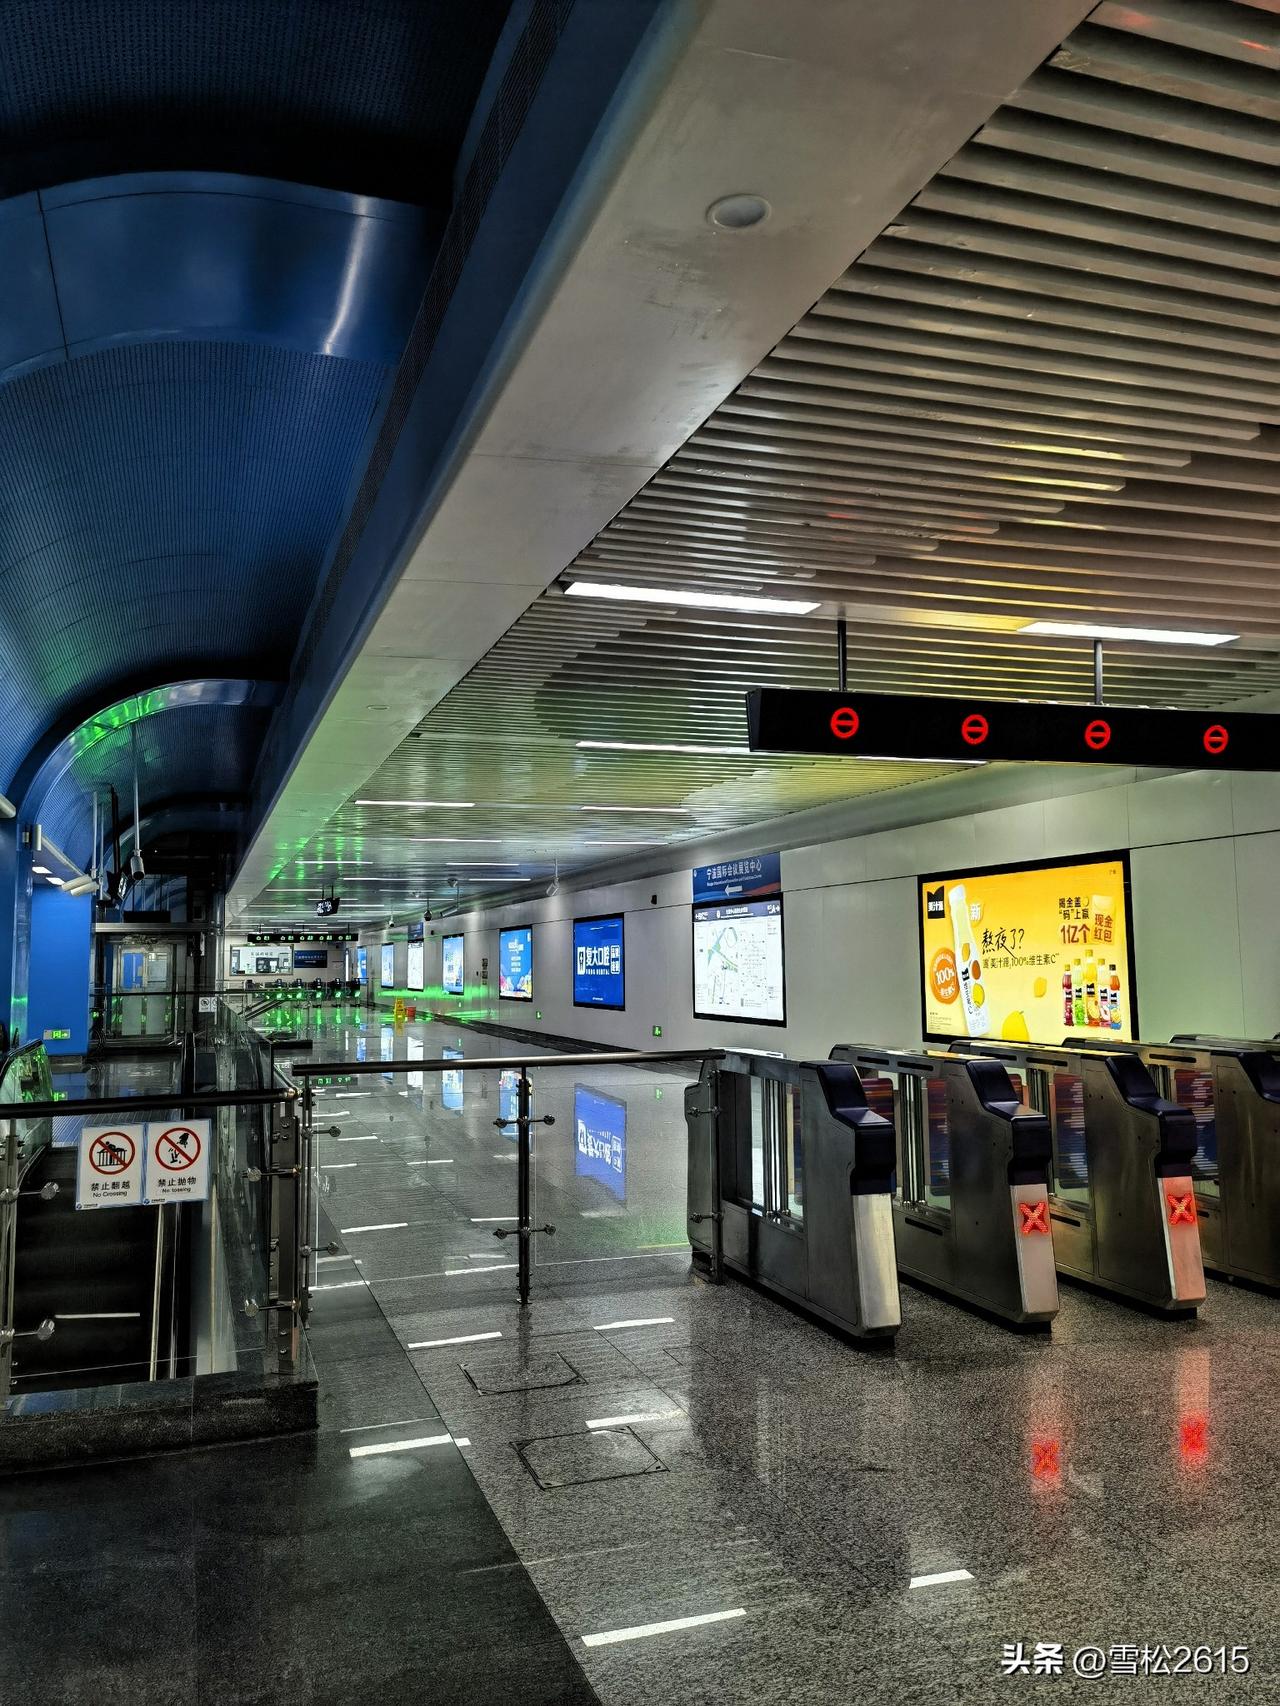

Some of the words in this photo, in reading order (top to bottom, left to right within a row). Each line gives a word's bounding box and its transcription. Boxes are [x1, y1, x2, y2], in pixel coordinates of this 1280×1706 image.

[1094, 913, 1114, 928] 现金
[1060, 923, 1091, 944] 1亿个
[1094, 927, 1113, 942] 红包
[91, 1181, 130, 1191] 禁止翻越
[158, 1177, 197, 1187] 禁止抛物
